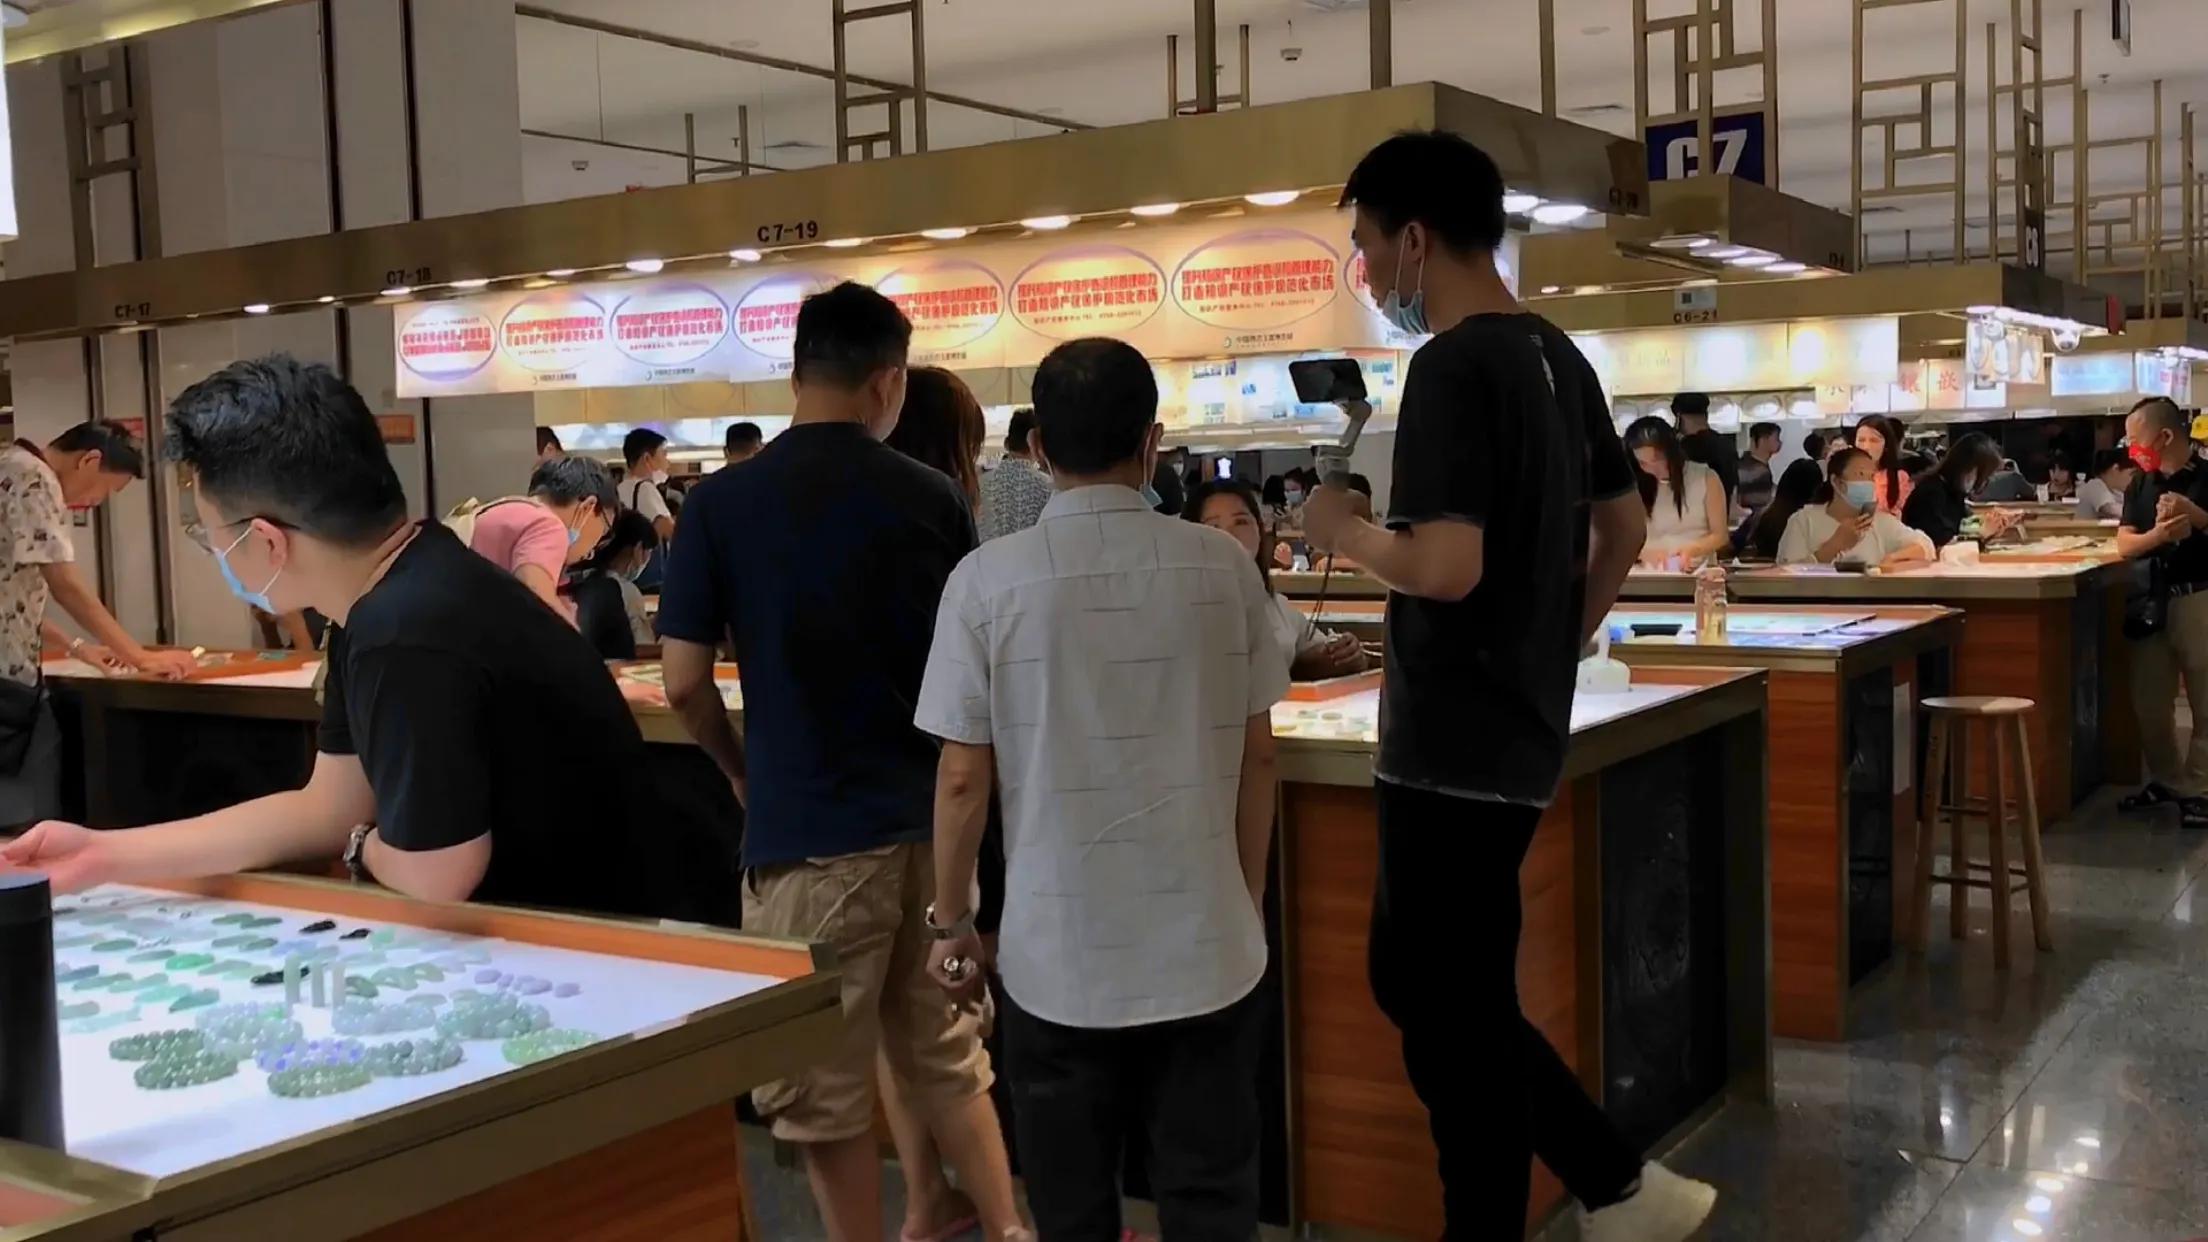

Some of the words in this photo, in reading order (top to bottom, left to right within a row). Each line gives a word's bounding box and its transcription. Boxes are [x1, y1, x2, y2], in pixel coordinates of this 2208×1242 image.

[1666, 129, 1747, 180] C7
[757, 220, 818, 242] C7-19
[386, 267, 432, 286] C7-18
[114, 302, 151, 318] C7-17
[1673, 309, 1718, 324] C6-21
